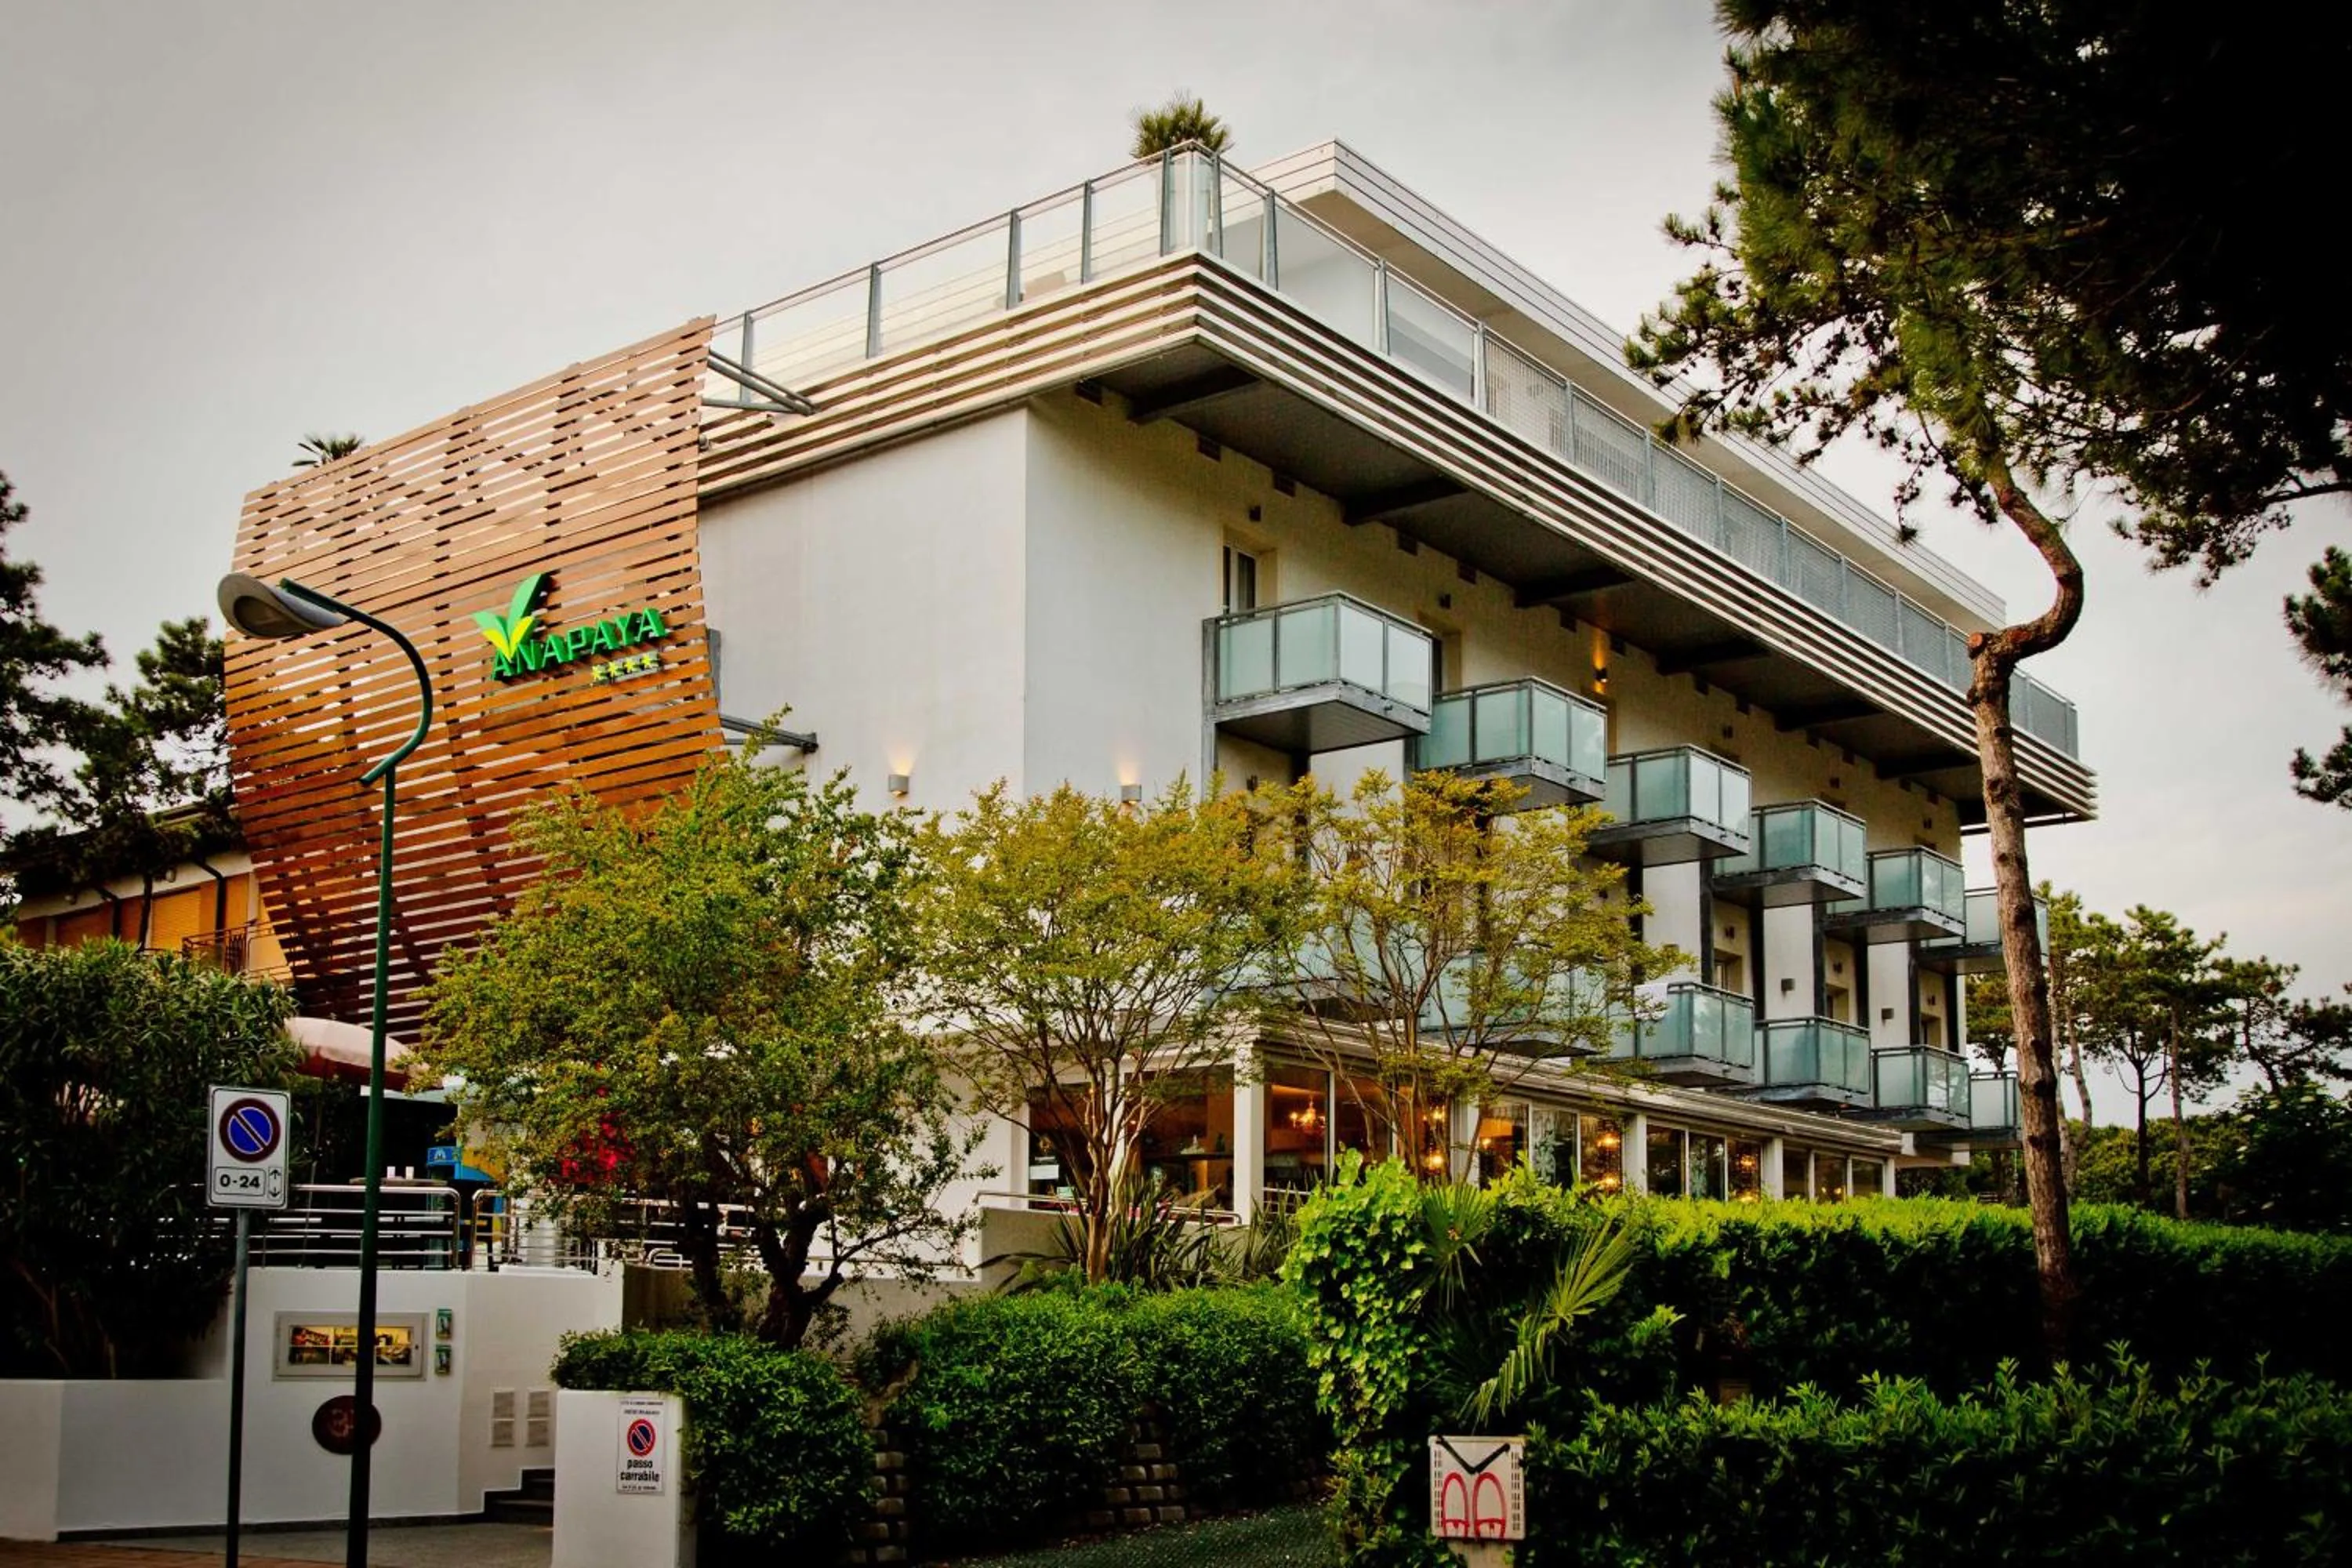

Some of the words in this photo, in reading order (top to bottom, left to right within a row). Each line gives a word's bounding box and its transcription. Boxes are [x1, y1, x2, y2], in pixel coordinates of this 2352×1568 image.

[491, 608, 667, 681] ANAPAYA
[627, 1460, 653, 1469] passo
[620, 1471, 659, 1482] carrabile
